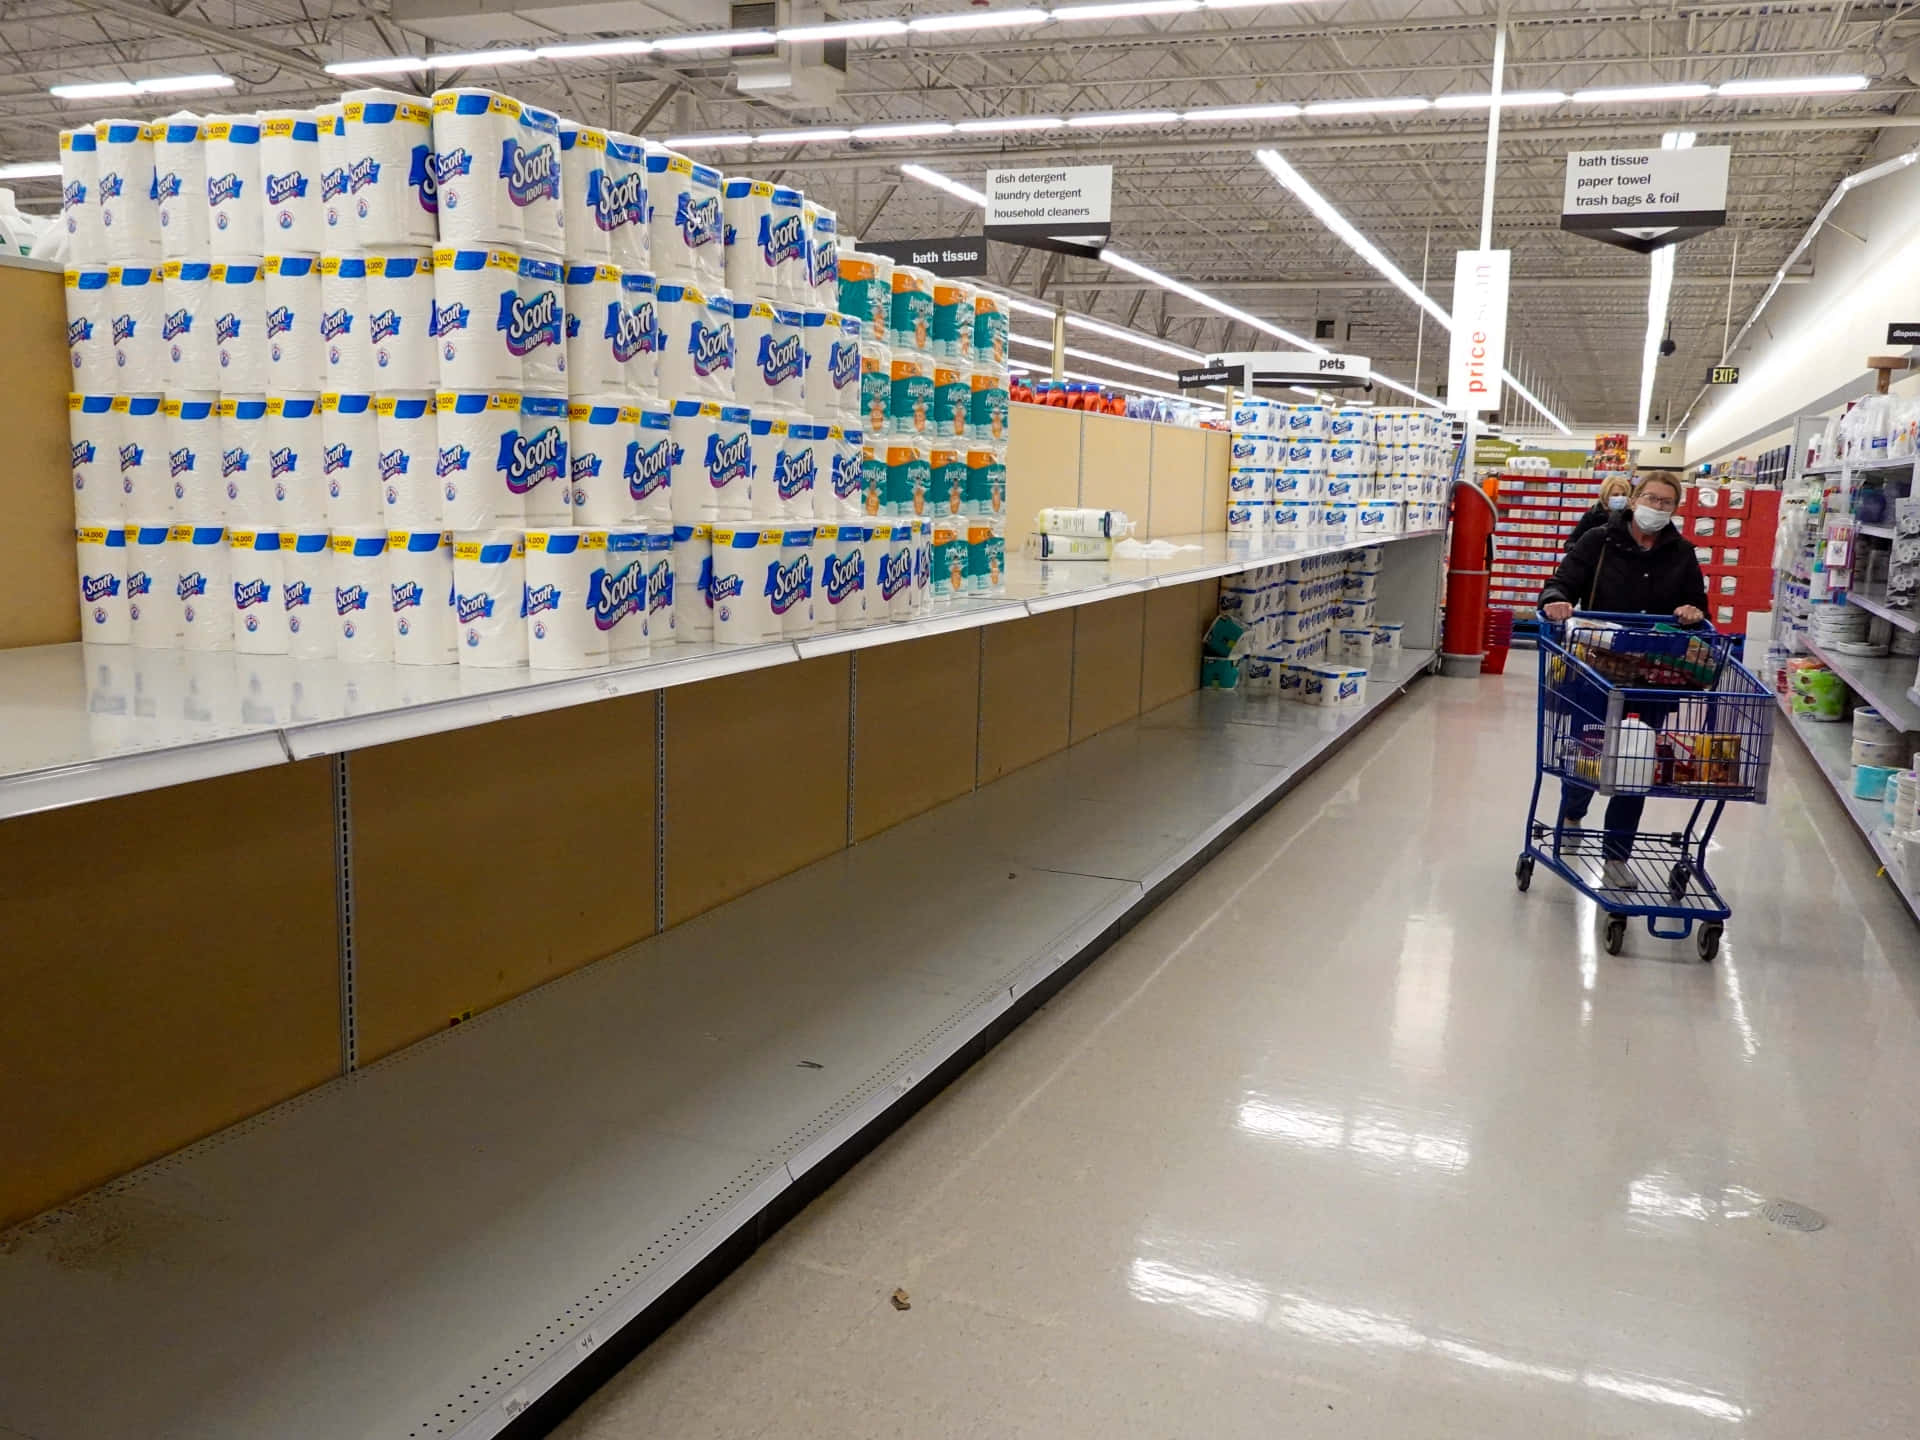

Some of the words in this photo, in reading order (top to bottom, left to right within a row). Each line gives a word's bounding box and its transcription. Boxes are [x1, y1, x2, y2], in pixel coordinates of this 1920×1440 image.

[350, 157, 373, 184] Scott
[438, 147, 466, 177] Scott
[512, 143, 552, 189] Scott
[1578, 155, 1607, 167] bath
[1611, 155, 1649, 167] tissue
[210, 173, 236, 196] Scott
[270, 171, 302, 193] Scott
[321, 168, 343, 192] Scott
[995, 173, 1015, 184] dish
[1018, 172, 1066, 184] detergent
[1577, 176, 1614, 189] paper
[1617, 173, 1652, 186] towel
[525, 183, 543, 203] 1000
[599, 172, 640, 215] Scott
[994, 189, 1031, 200] laundry
[1033, 188, 1082, 201] detergent
[1576, 194, 1608, 207] trash
[1611, 194, 1642, 208] bags
[1645, 193, 1656, 204] &
[1659, 192, 1680, 204] foil
[994, 207, 1045, 218] household
[1047, 206, 1090, 217] cleaners
[767, 215, 800, 252] Scott
[912, 252, 939, 264] bath
[942, 250, 978, 263] tissue
[324, 308, 346, 333] Scott
[370, 309, 394, 335] Scott
[438, 302, 462, 331] Scott
[511, 290, 554, 338] Scott
[617, 302, 652, 346] Scott
[525, 331, 544, 350] 1000
[697, 324, 730, 361] Scott
[767, 335, 800, 372] Scott
[836, 342, 859, 376] Scott
[1319, 357, 1346, 371] pets
[1464, 331, 1488, 393] price
[1712, 368, 1734, 384] EXIT
[1441, 411, 1457, 419] toys
[438, 444, 463, 469] Scott
[512, 425, 558, 478] Scott
[634, 439, 670, 485] Scott
[713, 433, 748, 473] Scott
[526, 466, 546, 488] 1000
[782, 448, 813, 487] Scott
[839, 450, 863, 487] Scott
[645, 476, 660, 496] 1000
[774, 554, 808, 601] Scott
[831, 547, 862, 590] Scott
[886, 547, 910, 588] Scott
[86, 573, 112, 594] Scott
[236, 578, 263, 602] Scott
[392, 582, 416, 604] Scott
[599, 561, 640, 613] Scott
[714, 575, 736, 594] Scott
[338, 585, 361, 608] Scott
[459, 592, 486, 617] Scott
[528, 584, 555, 609] Scott
[784, 588, 799, 608] 1000
[611, 601, 630, 623] 1000
